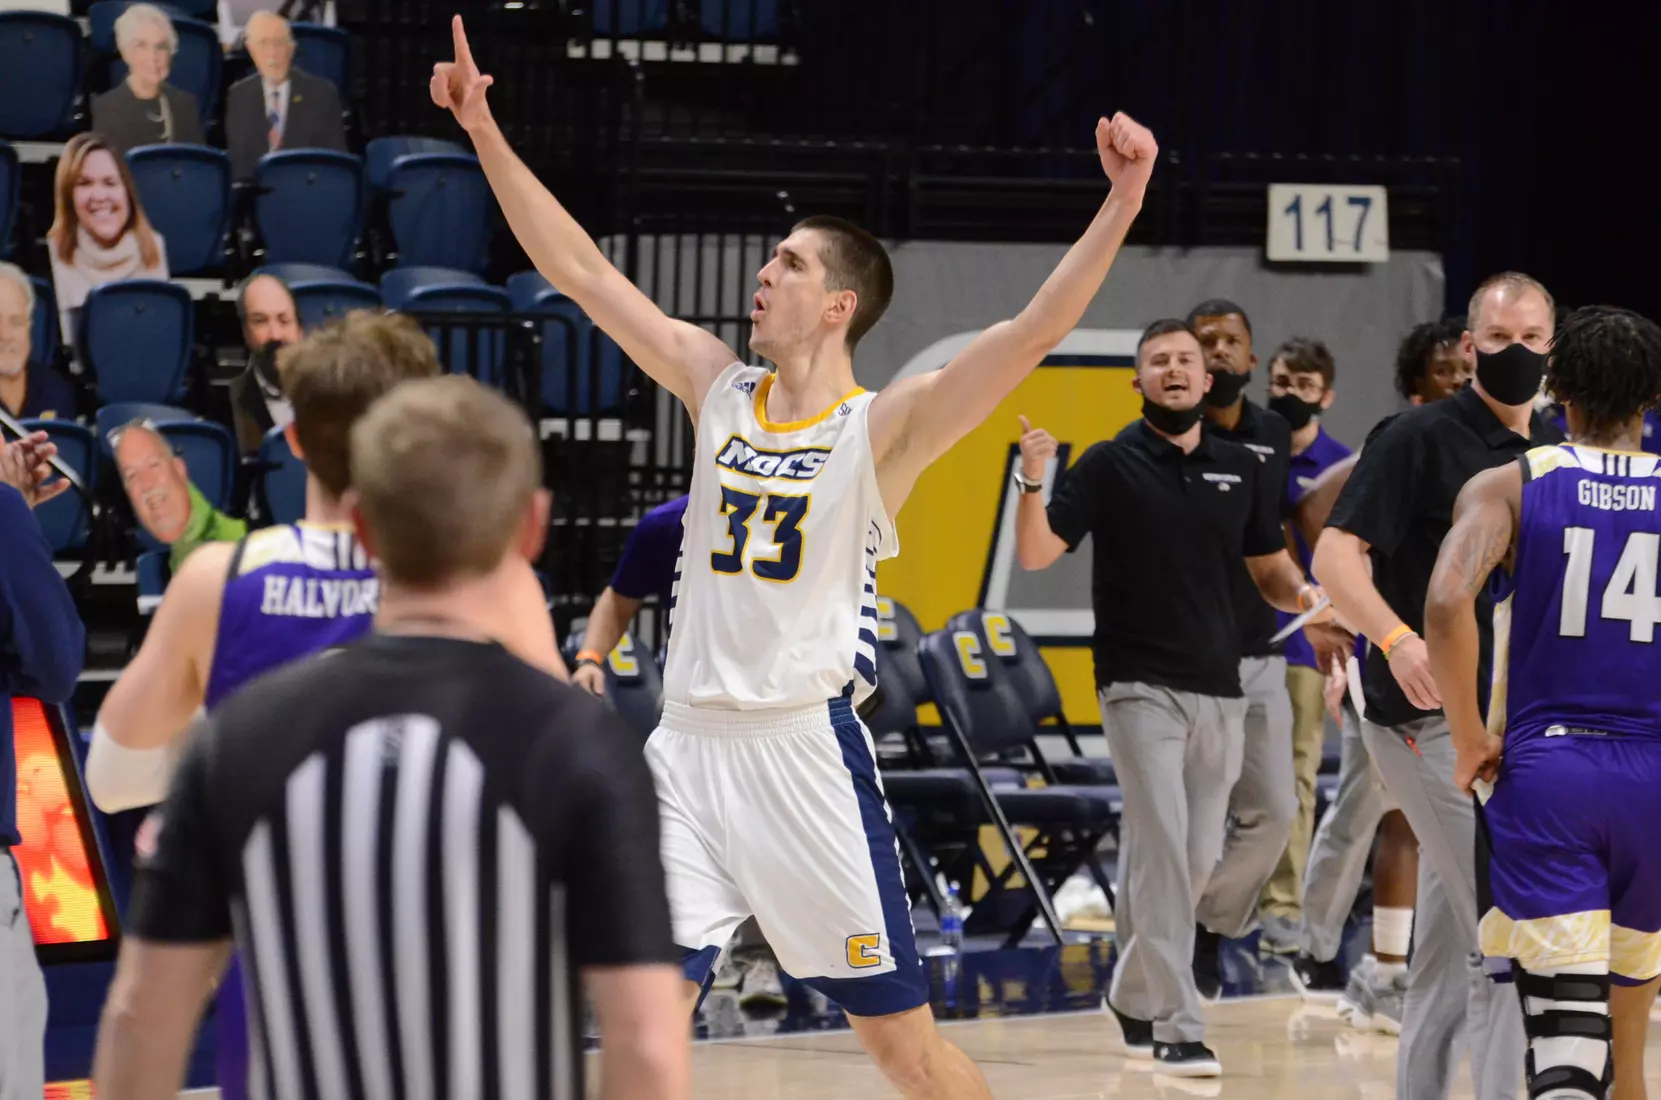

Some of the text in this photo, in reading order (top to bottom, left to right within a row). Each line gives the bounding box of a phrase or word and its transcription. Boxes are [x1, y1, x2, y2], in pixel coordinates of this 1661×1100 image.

[1284, 194, 1372, 252] 117
[1578, 479, 1656, 511] GIBSON
[711, 486, 809, 582] 33
[1559, 527, 1661, 643] 14
[953, 631, 987, 678] C
[981, 612, 1016, 656] C
[846, 933, 881, 968] C
